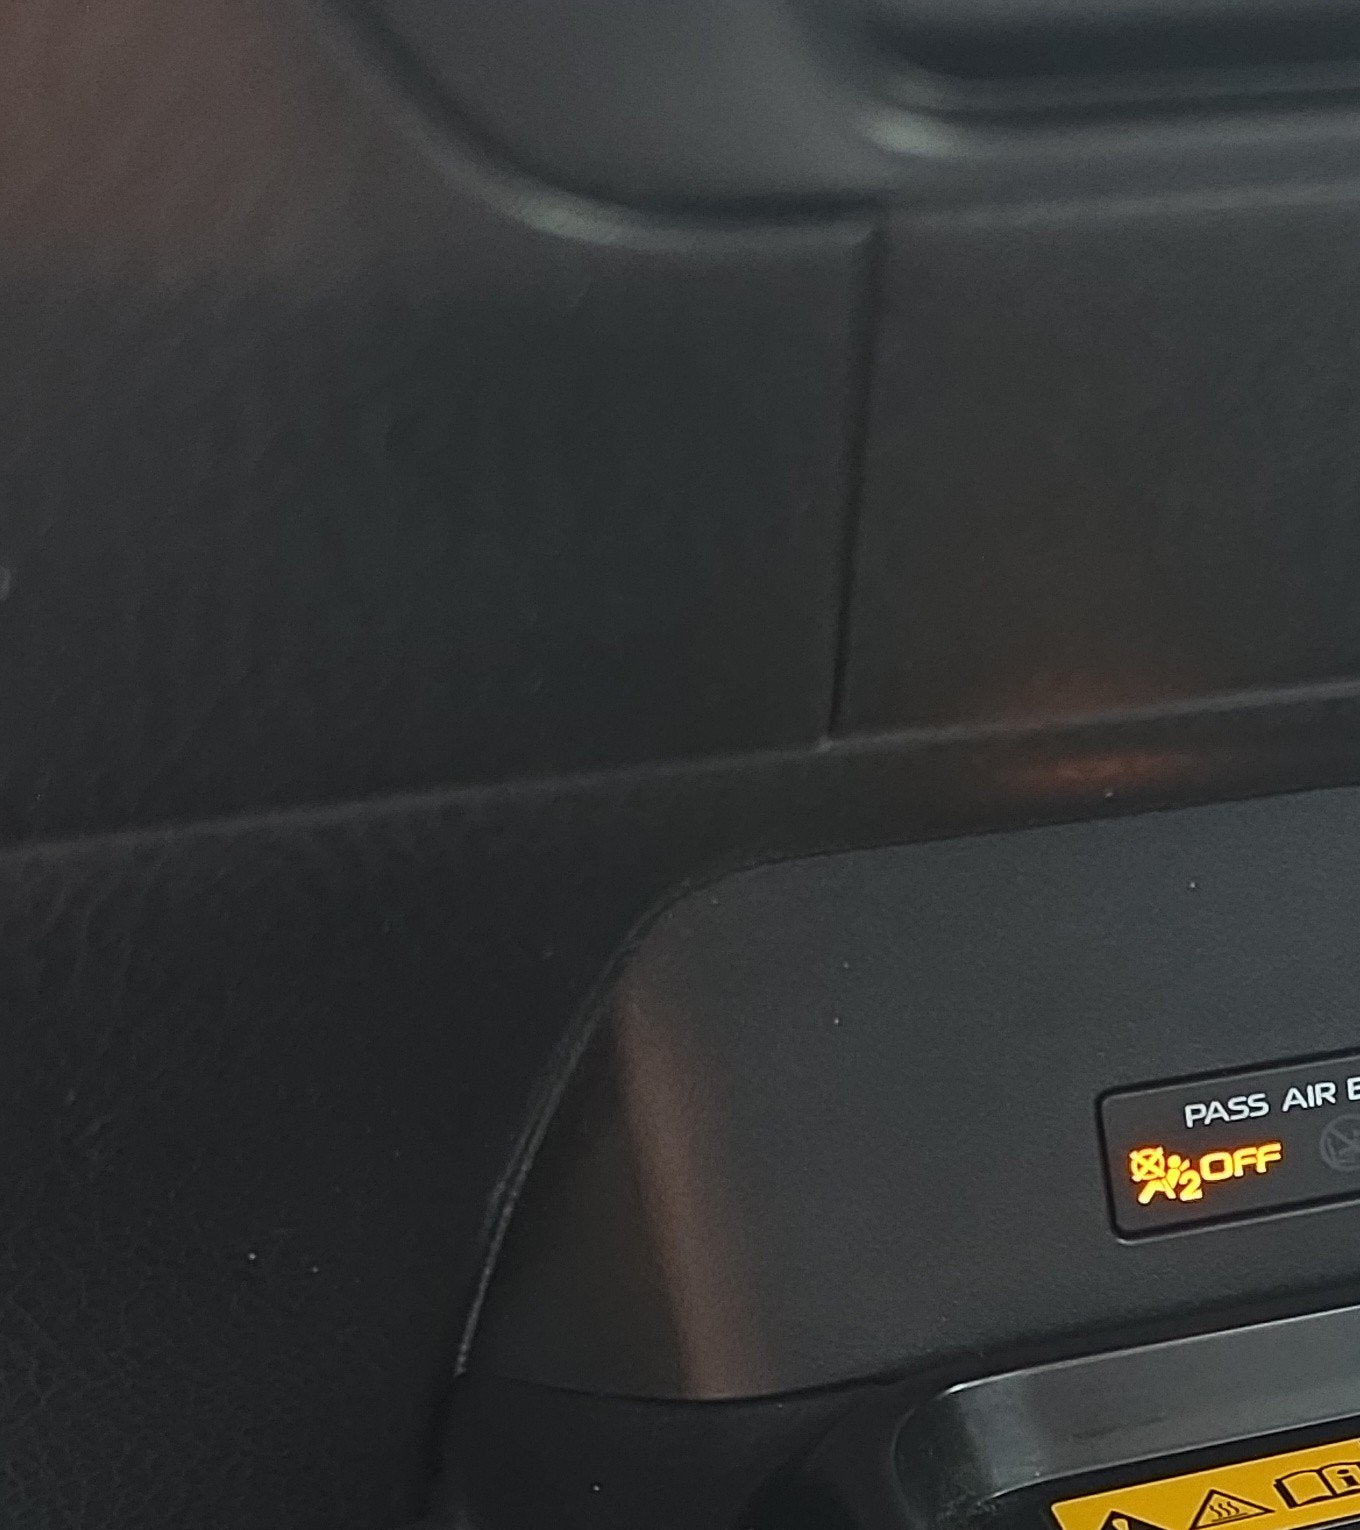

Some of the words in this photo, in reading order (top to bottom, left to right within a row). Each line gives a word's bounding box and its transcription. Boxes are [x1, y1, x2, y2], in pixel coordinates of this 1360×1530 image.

[1184, 1093, 1270, 1128] PASS
[1282, 1082, 1336, 1112] AIR
[1200, 1142, 1282, 1181] OFF
